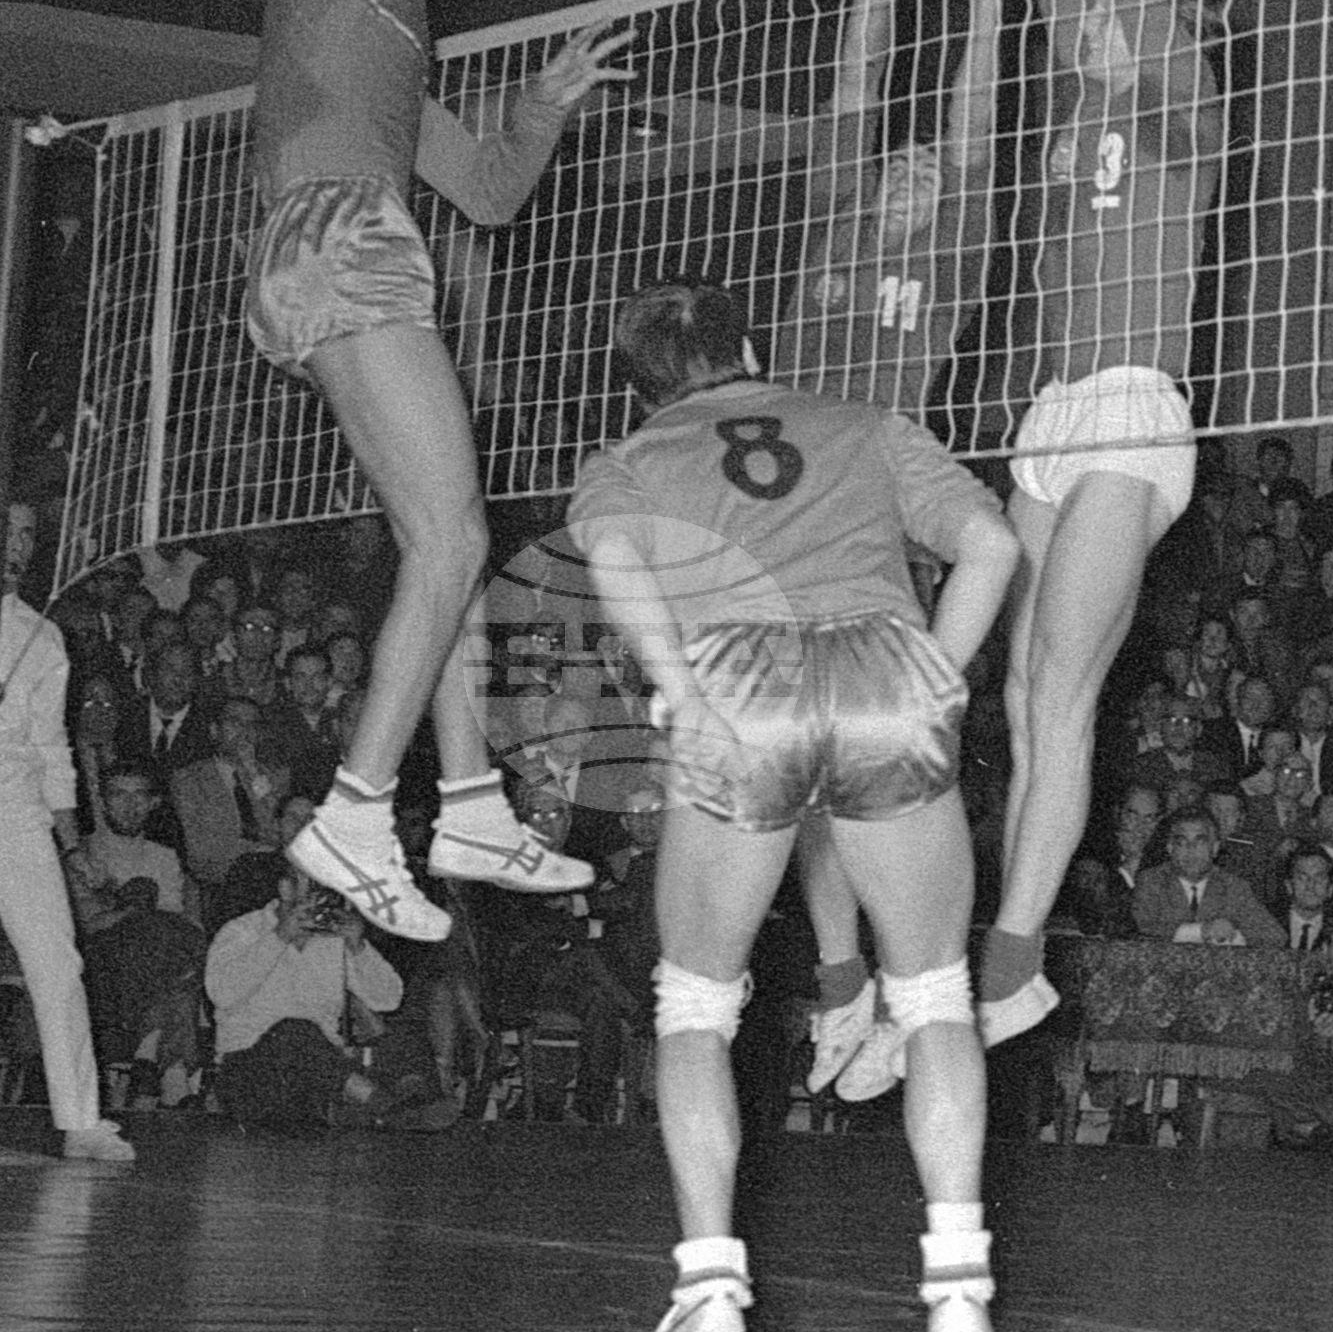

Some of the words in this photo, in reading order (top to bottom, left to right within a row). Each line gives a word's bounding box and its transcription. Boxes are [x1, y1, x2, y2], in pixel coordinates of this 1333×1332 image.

[1094, 132, 1125, 191] 3
[877, 275, 923, 332] 11
[715, 415, 804, 501] 8
